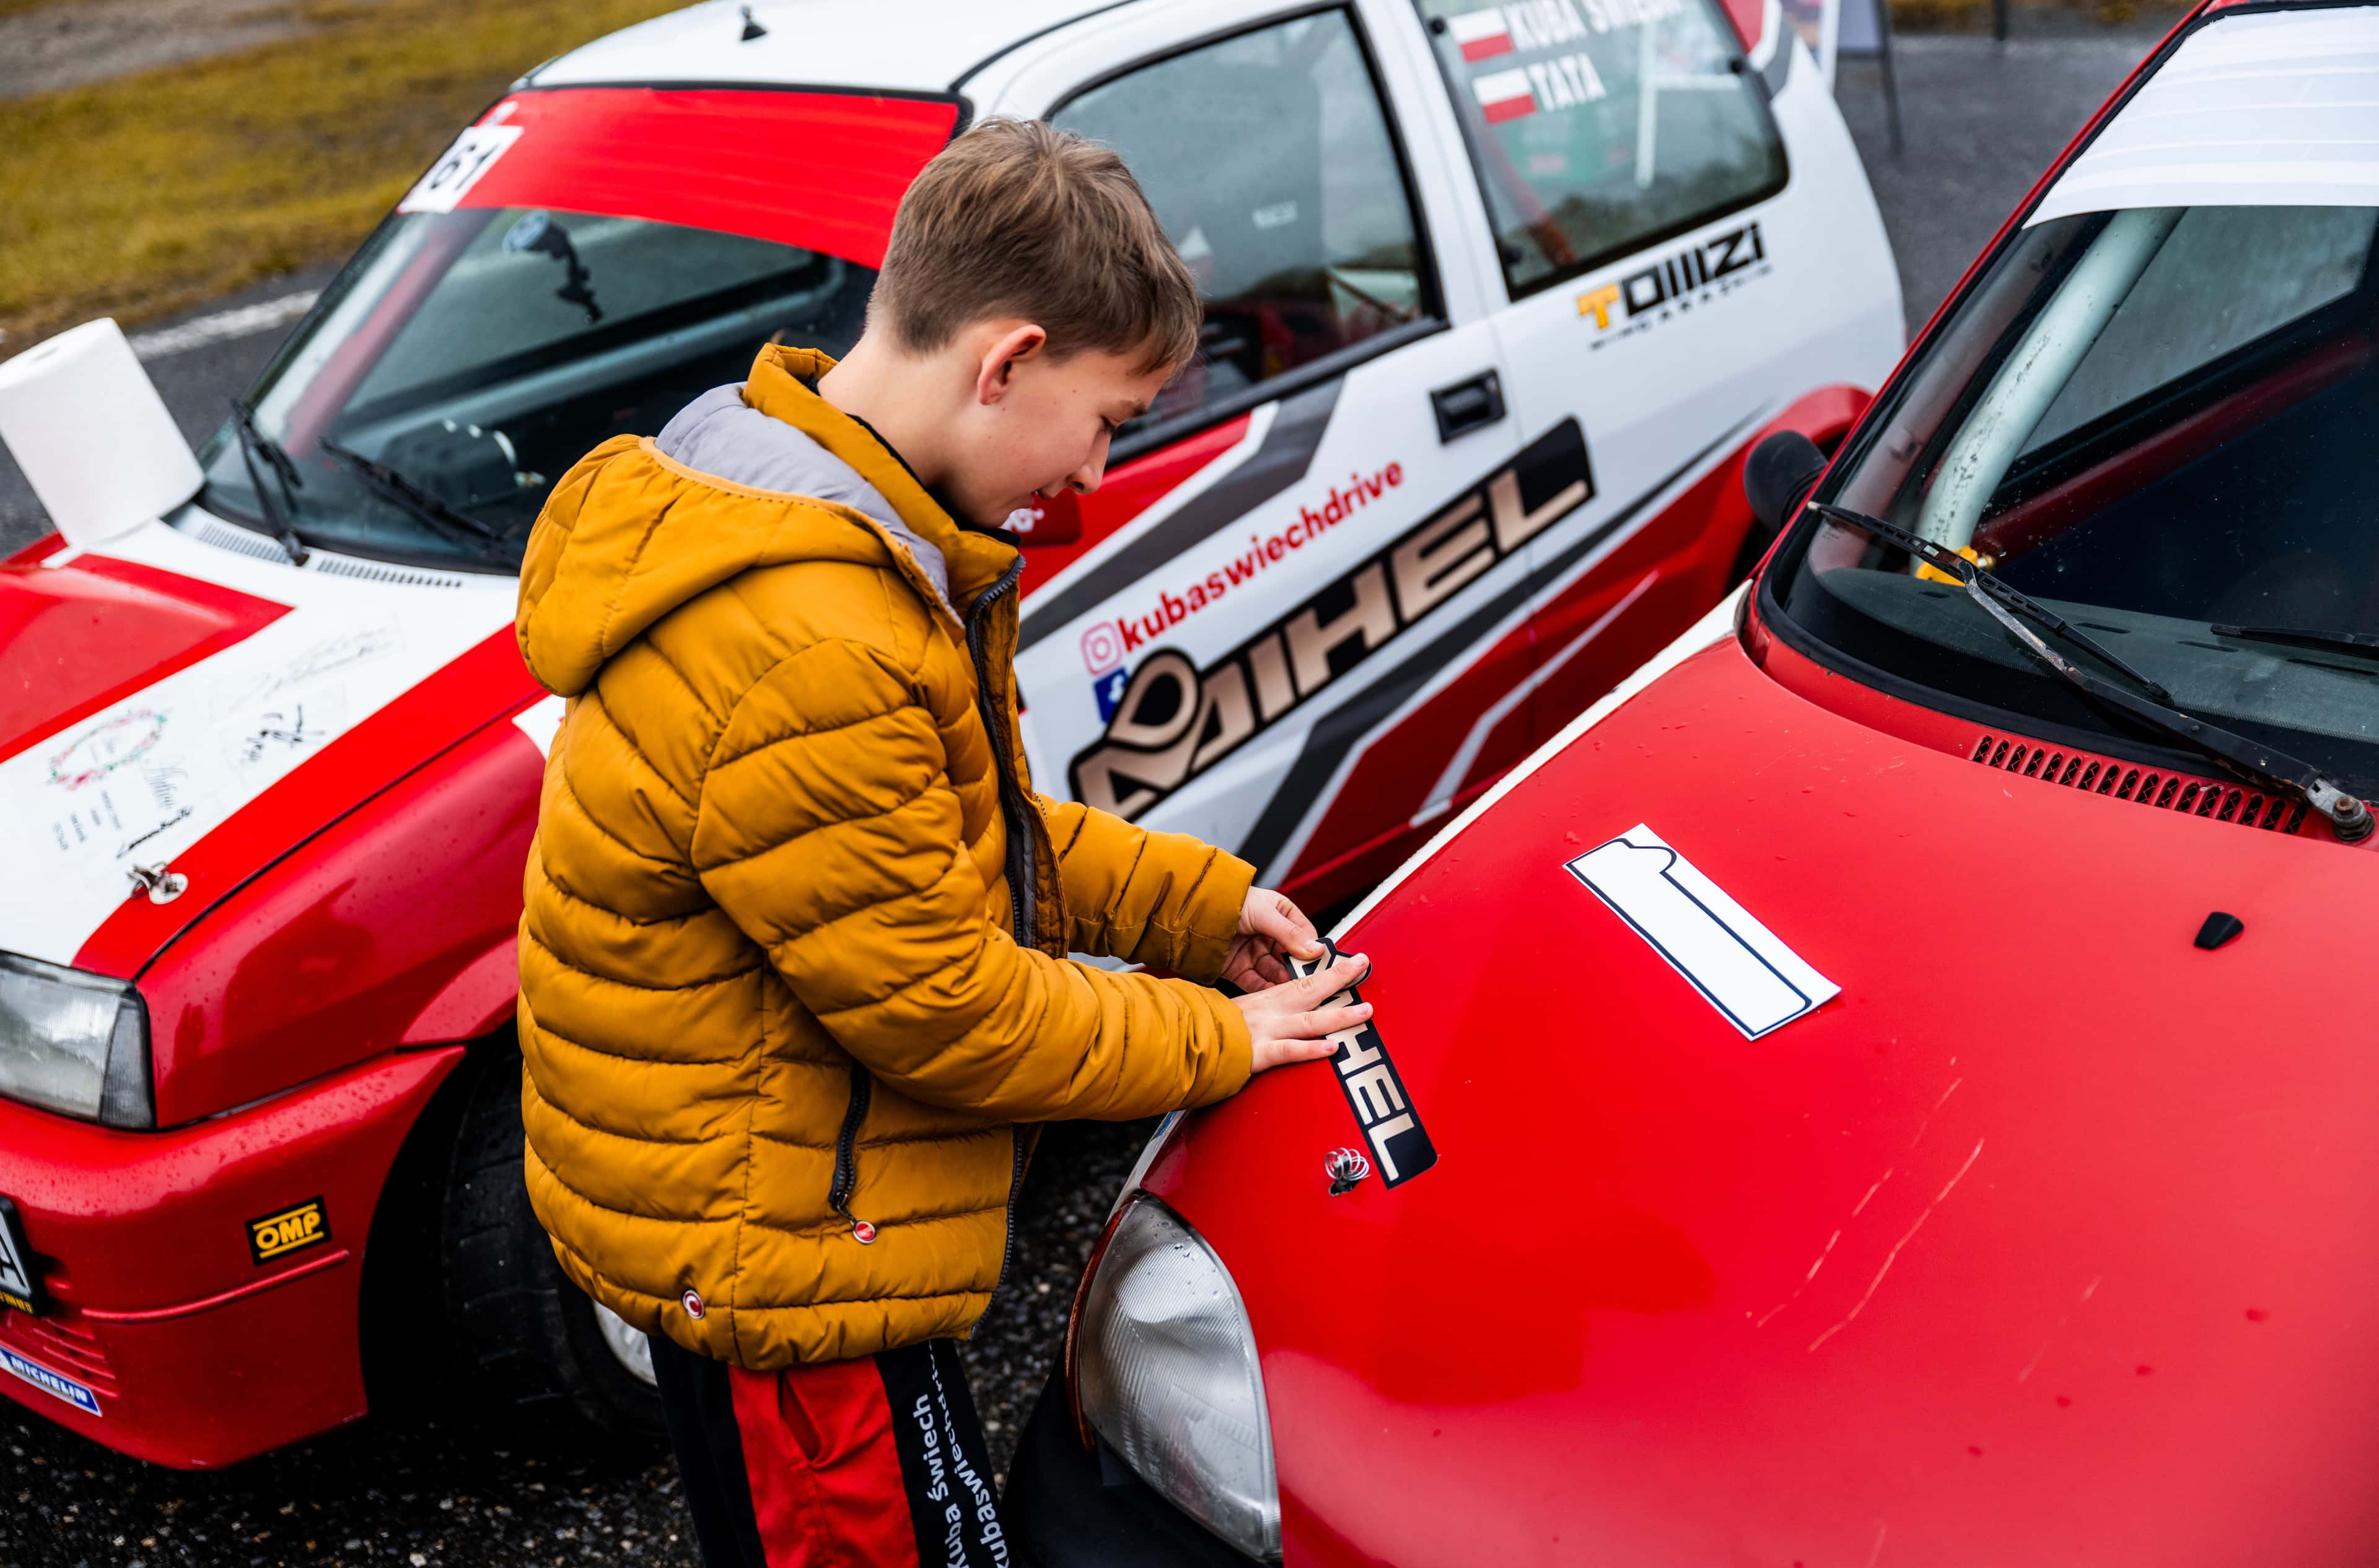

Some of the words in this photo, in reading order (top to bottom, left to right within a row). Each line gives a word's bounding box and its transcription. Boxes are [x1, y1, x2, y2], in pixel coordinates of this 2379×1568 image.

[1502, 0, 1587, 52] KUBA
[1527, 52, 1607, 113] TATA
[429, 142, 501, 191] 61
[1118, 462, 1403, 652] kubaswiechdrive
[255, 1210, 321, 1250] OMP
[10, 1356, 88, 1403] MICHELIN
[913, 1394, 949, 1502] Świech
